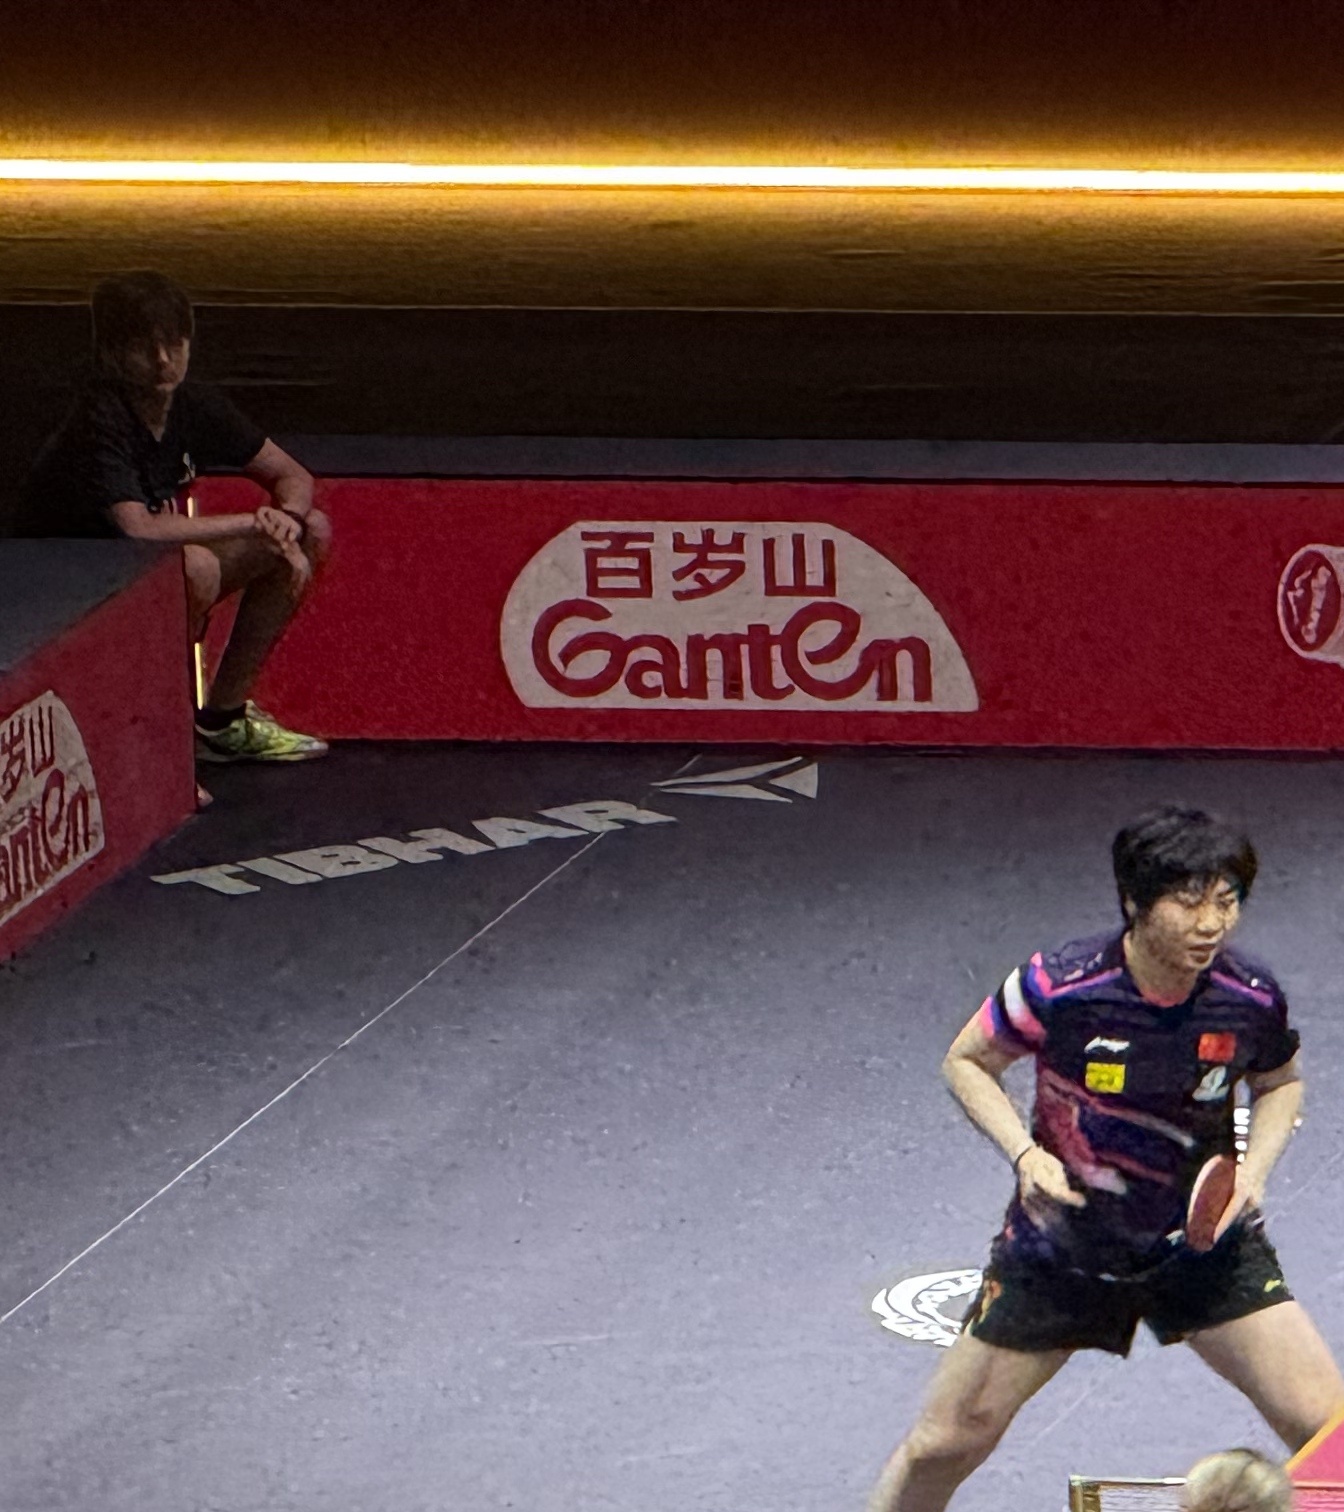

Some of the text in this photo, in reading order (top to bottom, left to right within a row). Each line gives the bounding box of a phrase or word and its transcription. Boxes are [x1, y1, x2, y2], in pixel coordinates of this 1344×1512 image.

[580, 528, 836, 601] 百岁山
[150, 799, 679, 896] TIBHAR
